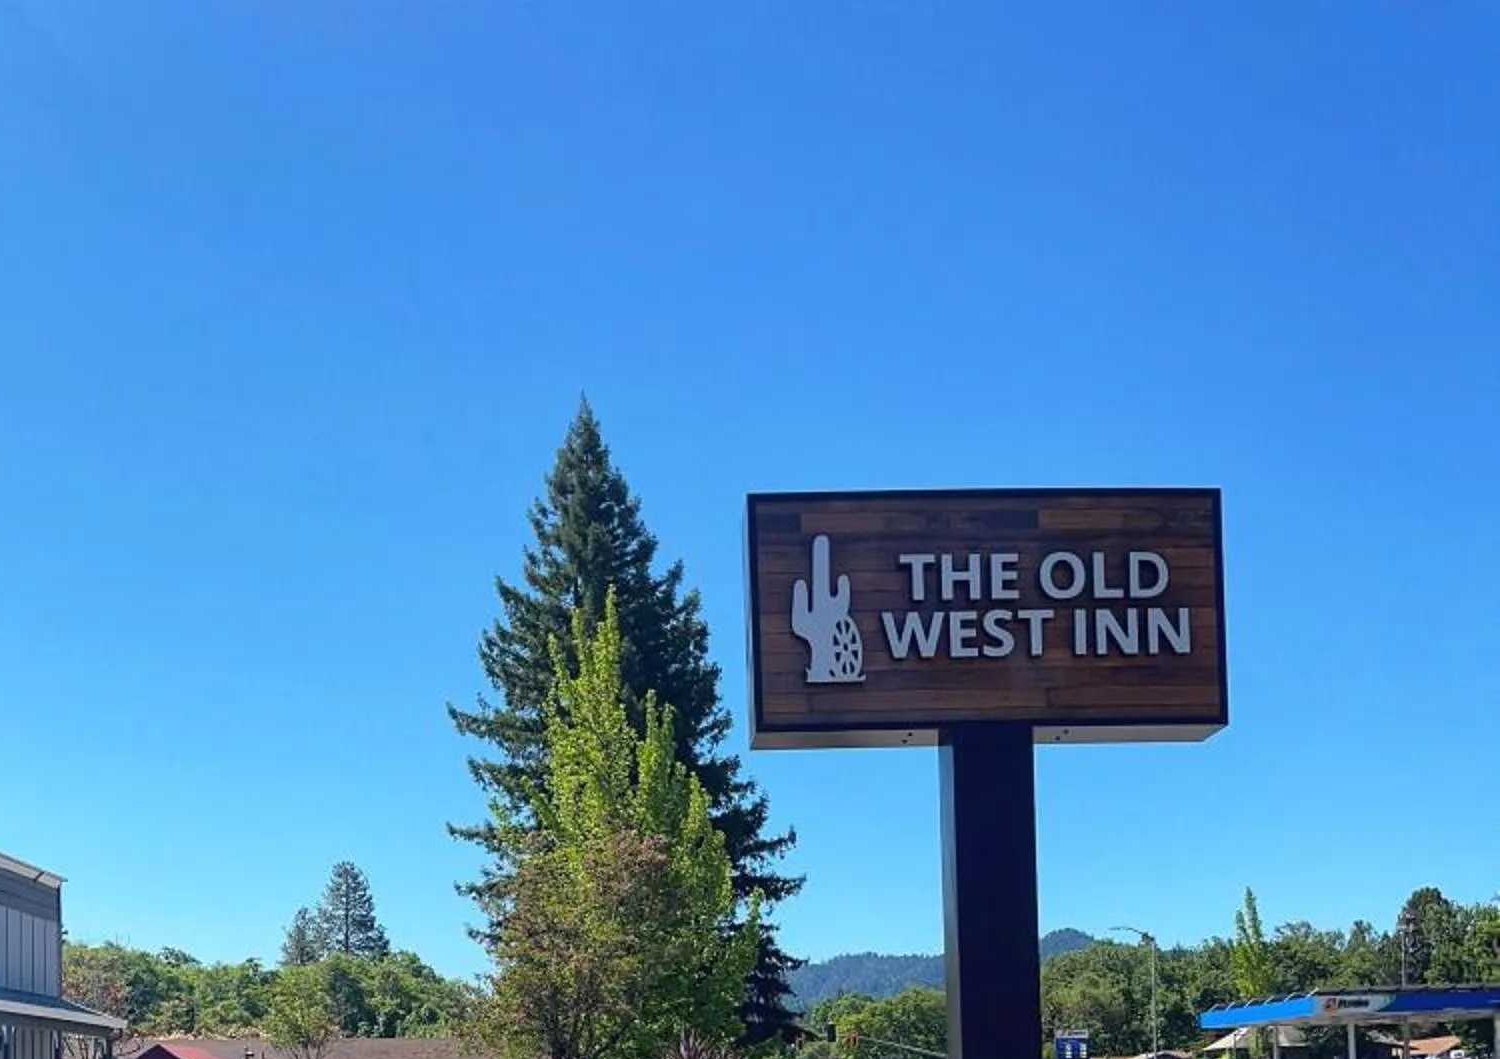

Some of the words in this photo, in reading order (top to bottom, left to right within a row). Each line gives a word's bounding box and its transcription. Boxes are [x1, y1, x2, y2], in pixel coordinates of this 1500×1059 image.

[899, 553, 1020, 601] THE
[1039, 550, 1170, 600] OLD
[881, 608, 1055, 659] WEST
[1073, 607, 1192, 657] INN
